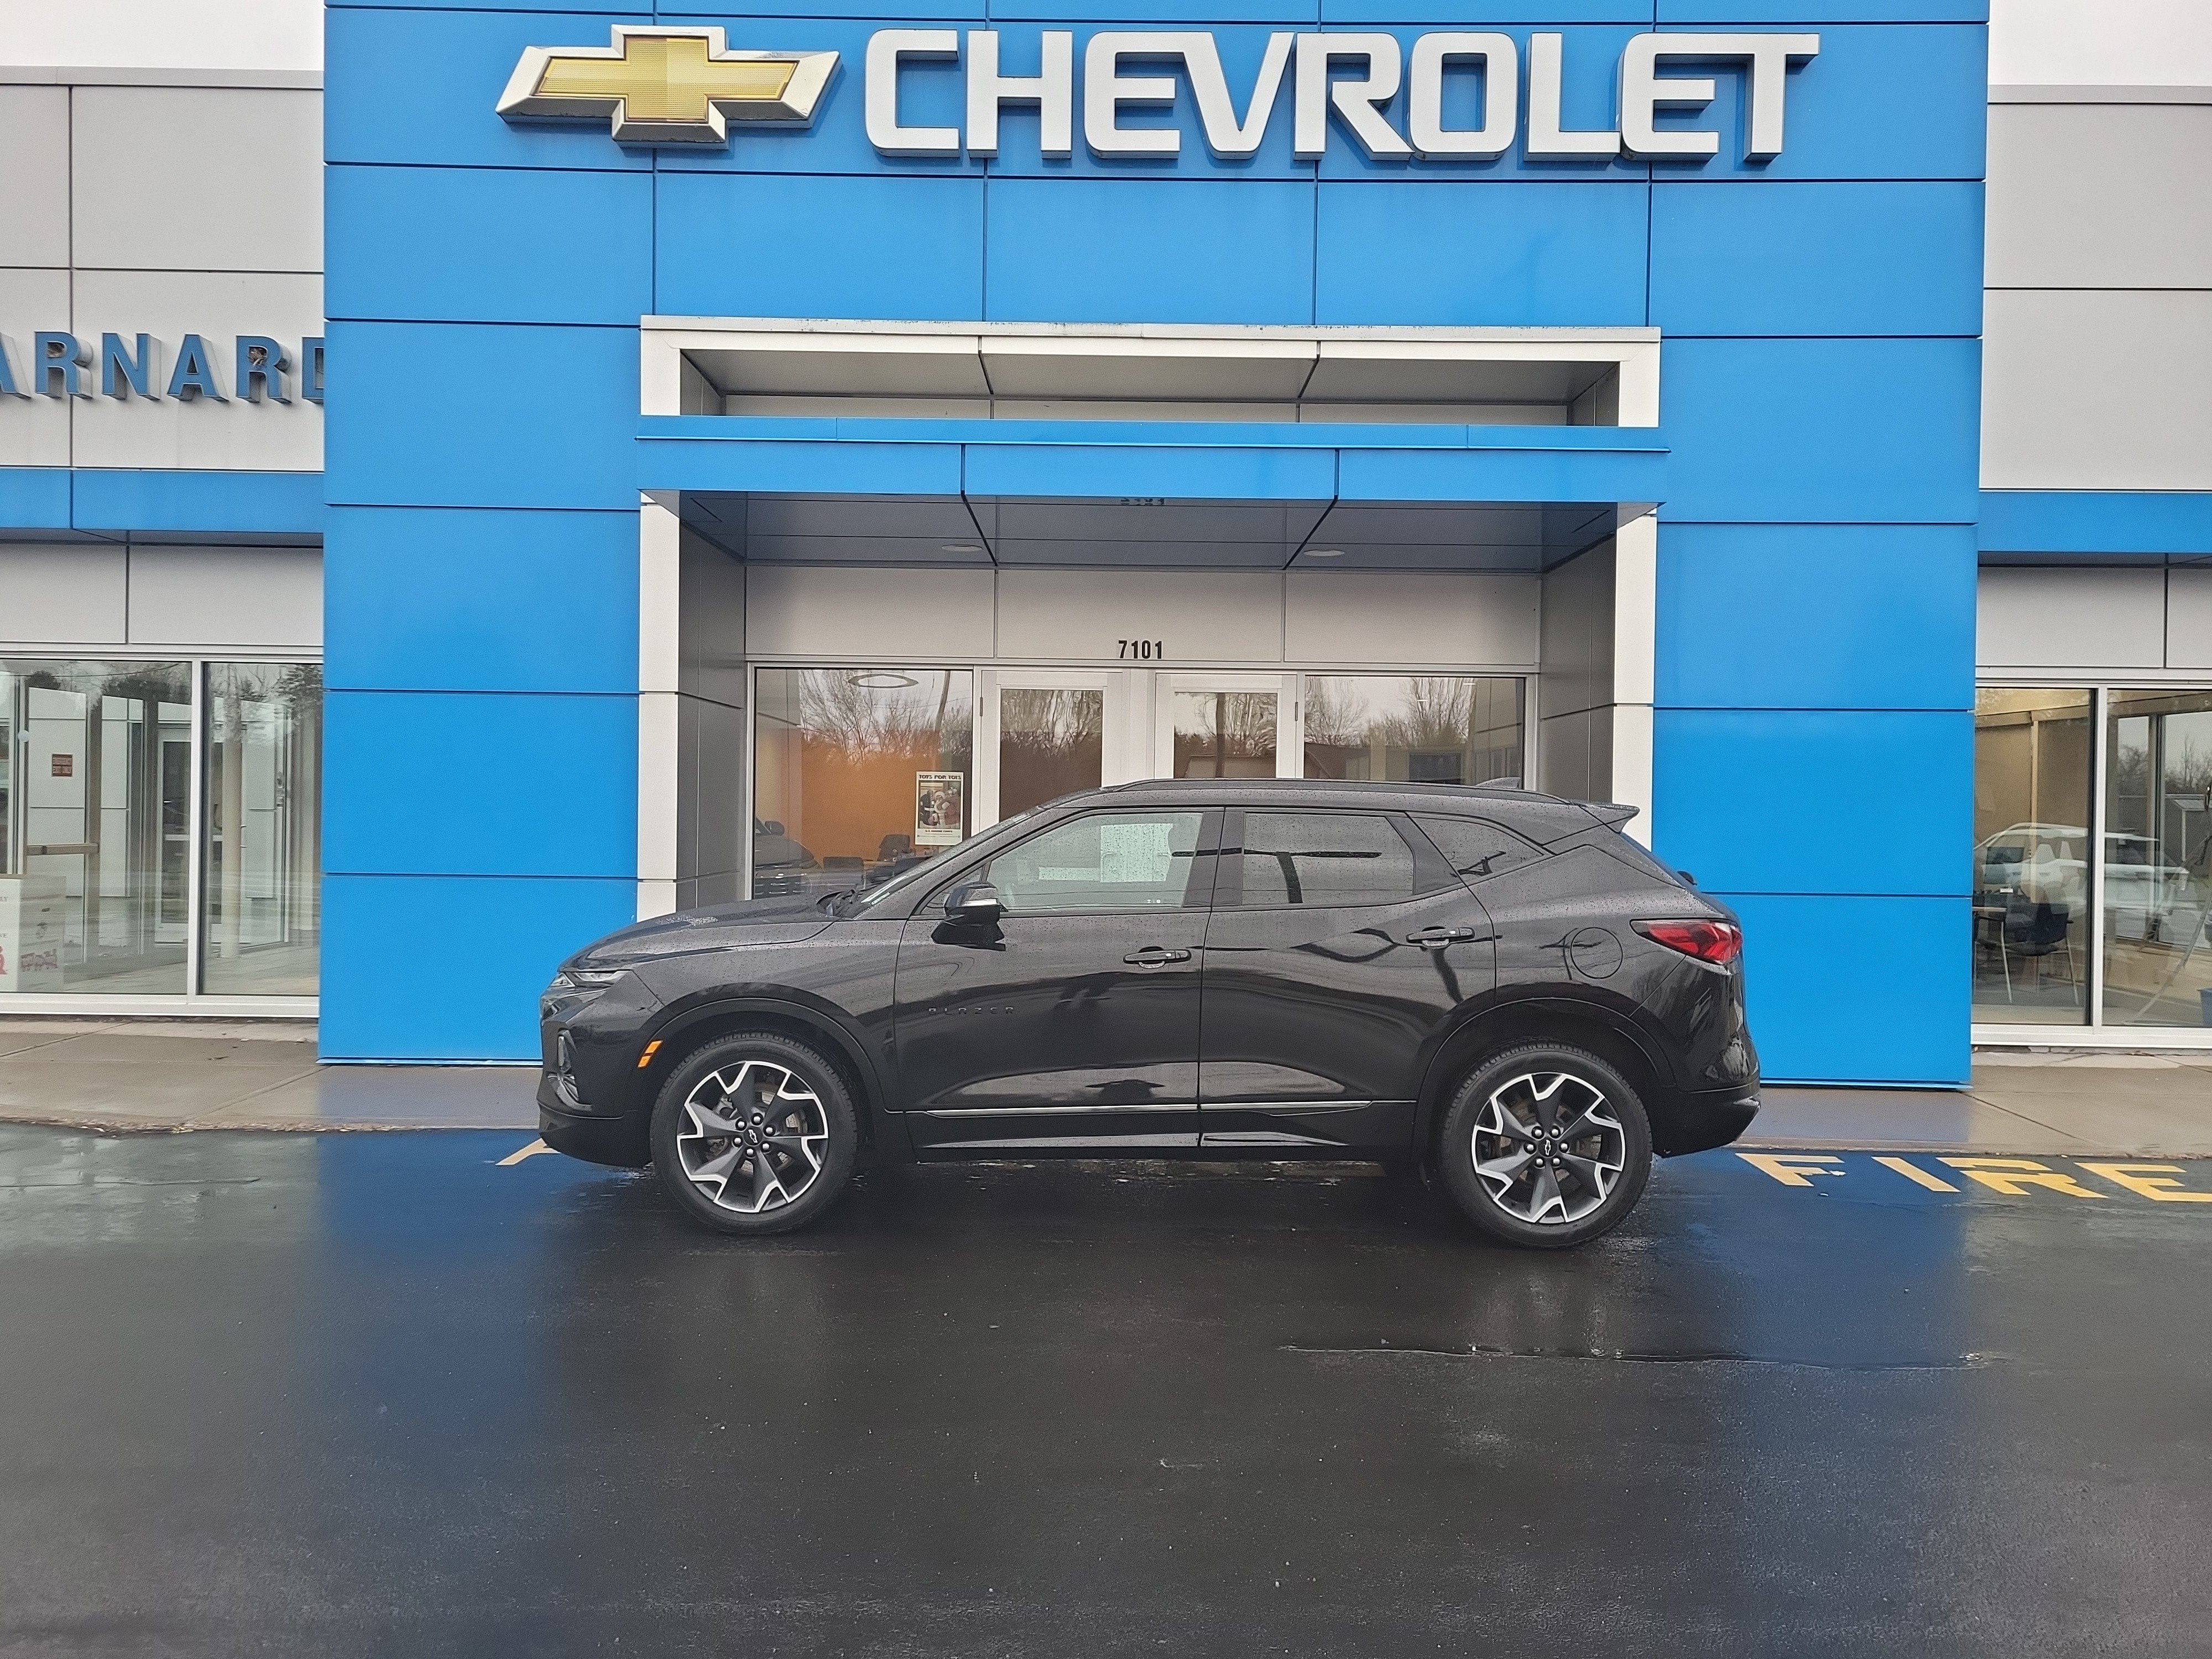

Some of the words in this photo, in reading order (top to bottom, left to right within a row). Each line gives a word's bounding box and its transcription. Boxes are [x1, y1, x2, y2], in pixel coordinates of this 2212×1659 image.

[865, 29, 1820, 158] CHEVROLET
[0, 331, 324, 404] RNAR
[1118, 640, 1162, 659] 7101
[928, 1006, 1014, 1015] BLAZER
[1735, 1152, 2212, 1202] FIRE
